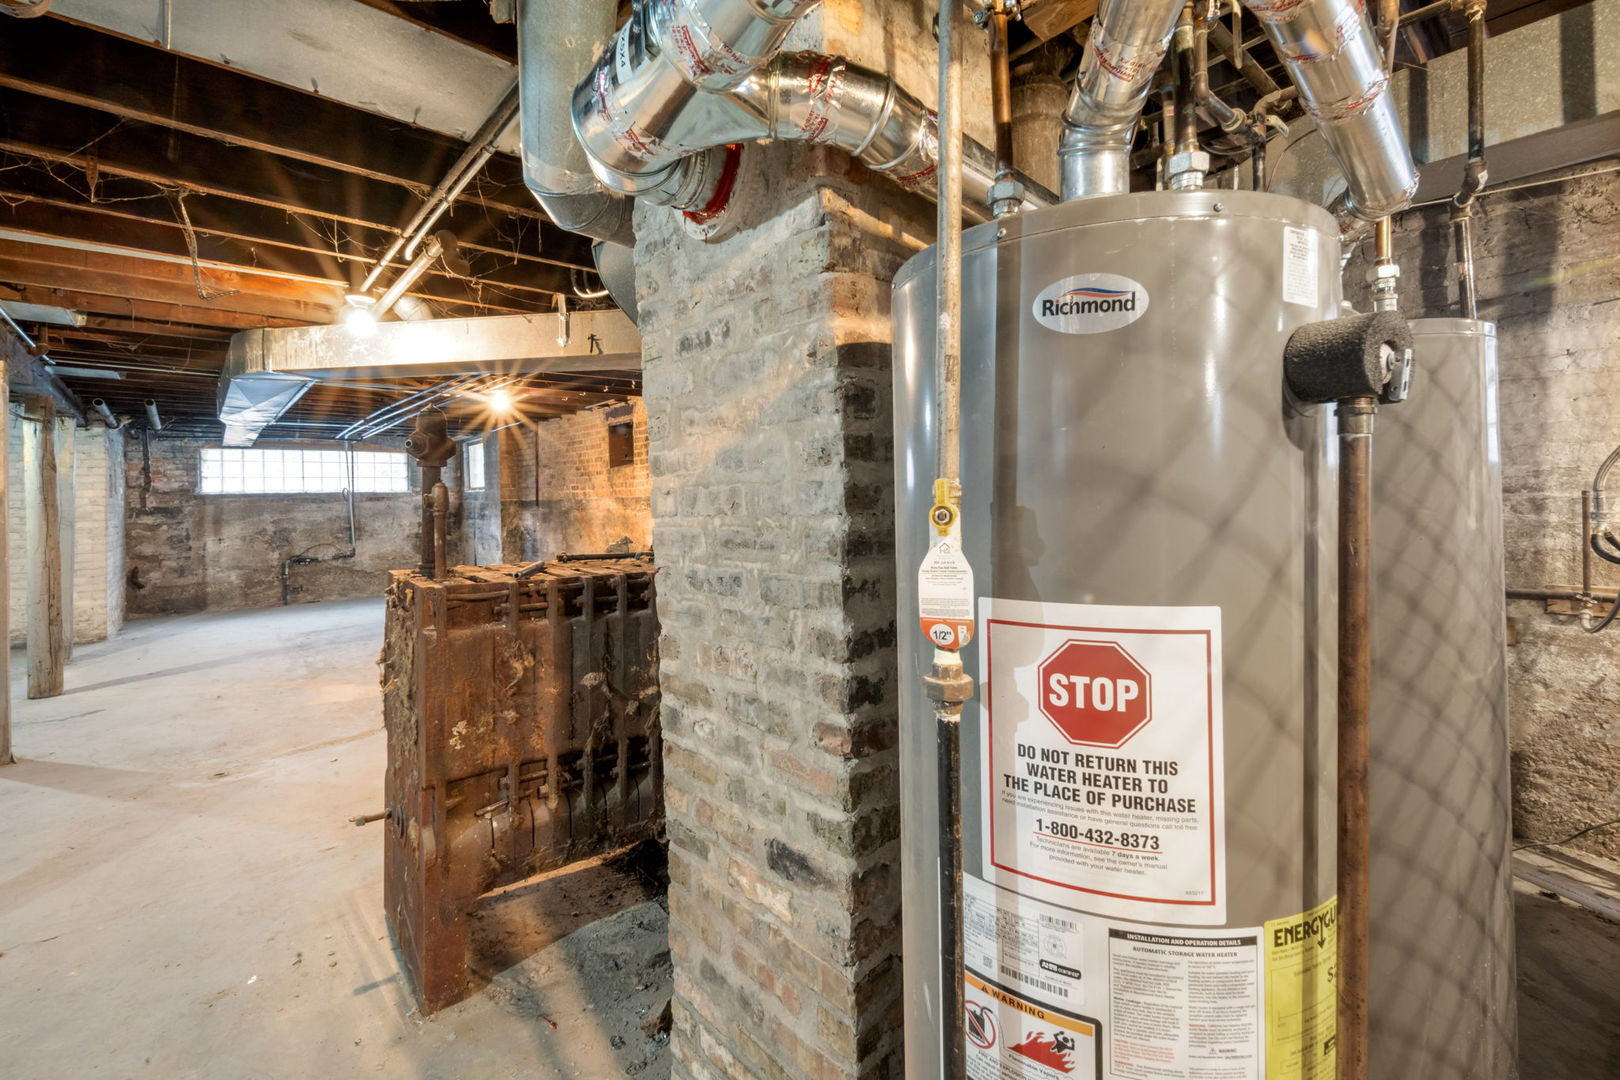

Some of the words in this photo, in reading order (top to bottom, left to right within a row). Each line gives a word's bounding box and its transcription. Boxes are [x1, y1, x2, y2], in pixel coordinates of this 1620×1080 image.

[1042, 291, 1136, 317] Richmond
[933, 630, 952, 641] 1/2"
[1049, 673, 1139, 713] STOP
[1018, 743, 1036, 760] DO
[1041, 747, 1070, 766] NOT
[1075, 753, 1137, 774] RETURN
[1142, 759, 1178, 776] THIS
[1026, 762, 1077, 785] WATER
[1082, 772, 1142, 793] HEATER
[1148, 778, 1168, 794] TO
[1004, 774, 1029, 793] THE
[1034, 781, 1081, 803] PLACE
[1086, 790, 1106, 806] OF
[1112, 793, 1196, 813] PURCHASE
[1007, 792, 1016, 800] you
[1028, 797, 1064, 809] experiencing
[1065, 805, 1085, 813] issues
[1156, 816, 1180, 824] missing
[1016, 801, 1045, 813] installation
[1047, 808, 1078, 820] assistance
[1088, 815, 1103, 823] have
[1105, 819, 1129, 828] general
[1130, 821, 1160, 830] questions
[1036, 818, 1160, 850] 1-800-432-8373
[1037, 836, 1070, 849] Technicians
[1083, 846, 1110, 856] available
[1117, 852, 1134, 860] days
[1040, 845, 1056, 853] more
[1118, 859, 1143, 867] owner's
[1049, 854, 1075, 865] provided
[1076, 860, 1089, 868] with
[1090, 863, 1104, 871] your
[1105, 865, 1123, 873] water
[1127, 933, 1170, 945] INSTALLATION
[1170, 937, 1184, 946] AND
[1184, 938, 1218, 947] OPERATION
[1218, 938, 1241, 947] DETAILS
[1132, 946, 1167, 956] AUTOMATIC
[1168, 950, 1195, 958] STORAGE
[992, 989, 1045, 1020] WARNING
